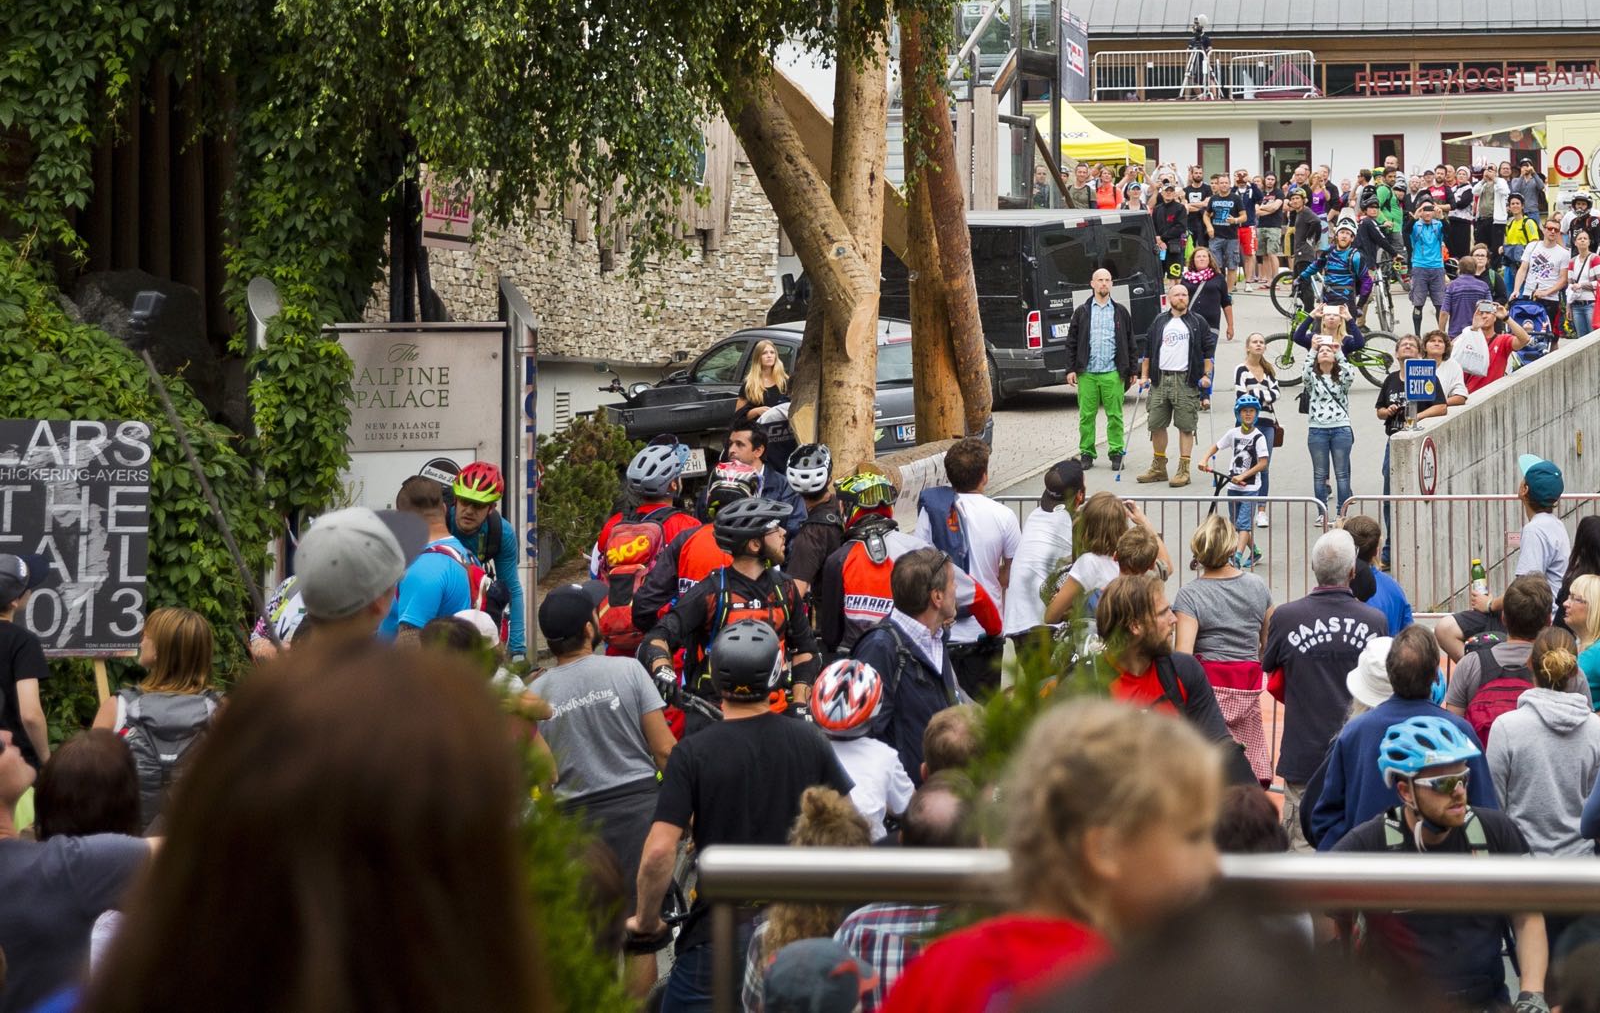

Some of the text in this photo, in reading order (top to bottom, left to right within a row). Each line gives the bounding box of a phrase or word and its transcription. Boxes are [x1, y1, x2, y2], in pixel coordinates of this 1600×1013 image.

[388, 343, 420, 363] The
[358, 367, 450, 386] ALPINE
[1408, 365, 1434, 377] AUSFAHRT
[1409, 379, 1425, 395] EXIT
[356, 389, 450, 409] PALACE
[392, 421, 441, 430] BALANCE
[365, 431, 441, 441] LUXUS RESORT
[0, 468, 149, 482] HICKERING-AYERS
[0, 485, 149, 533] THE
[0, 534, 147, 583] ALL
[24, 587, 145, 638] 013
[1298, 633, 1333, 654] SINCE
